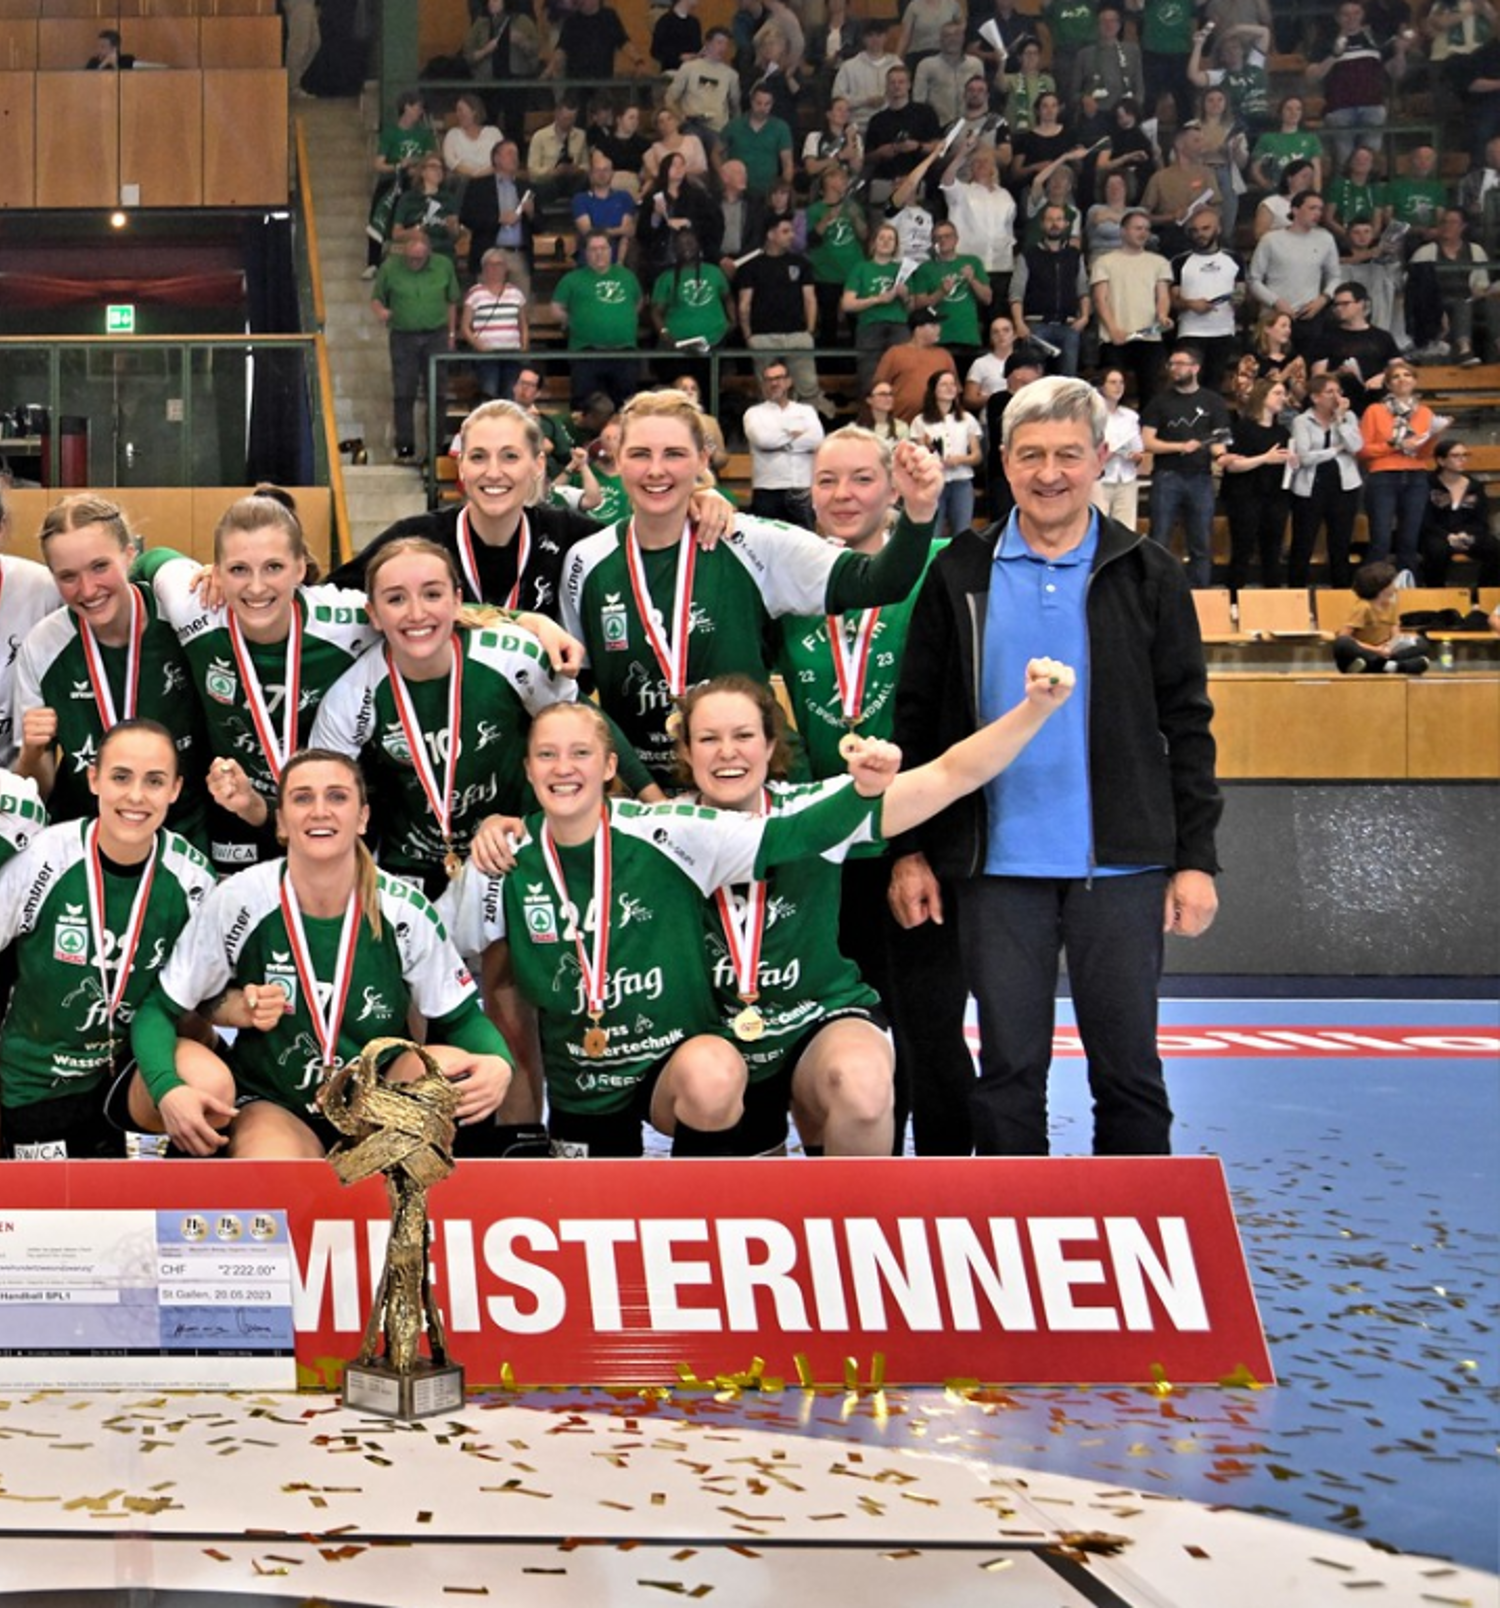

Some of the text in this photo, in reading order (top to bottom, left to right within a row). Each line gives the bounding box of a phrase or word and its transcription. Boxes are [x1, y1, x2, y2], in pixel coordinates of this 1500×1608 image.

[177, 613, 210, 640] tner
[876, 651, 895, 667] 23
[713, 956, 799, 991] frfag
[571, 967, 664, 1014] fifag
[566, 1028, 684, 1058] Wertechnik
[585, 1025, 629, 1042] yss
[161, 1264, 187, 1275] CHF
[0, 1290, 43, 1301] Handball
